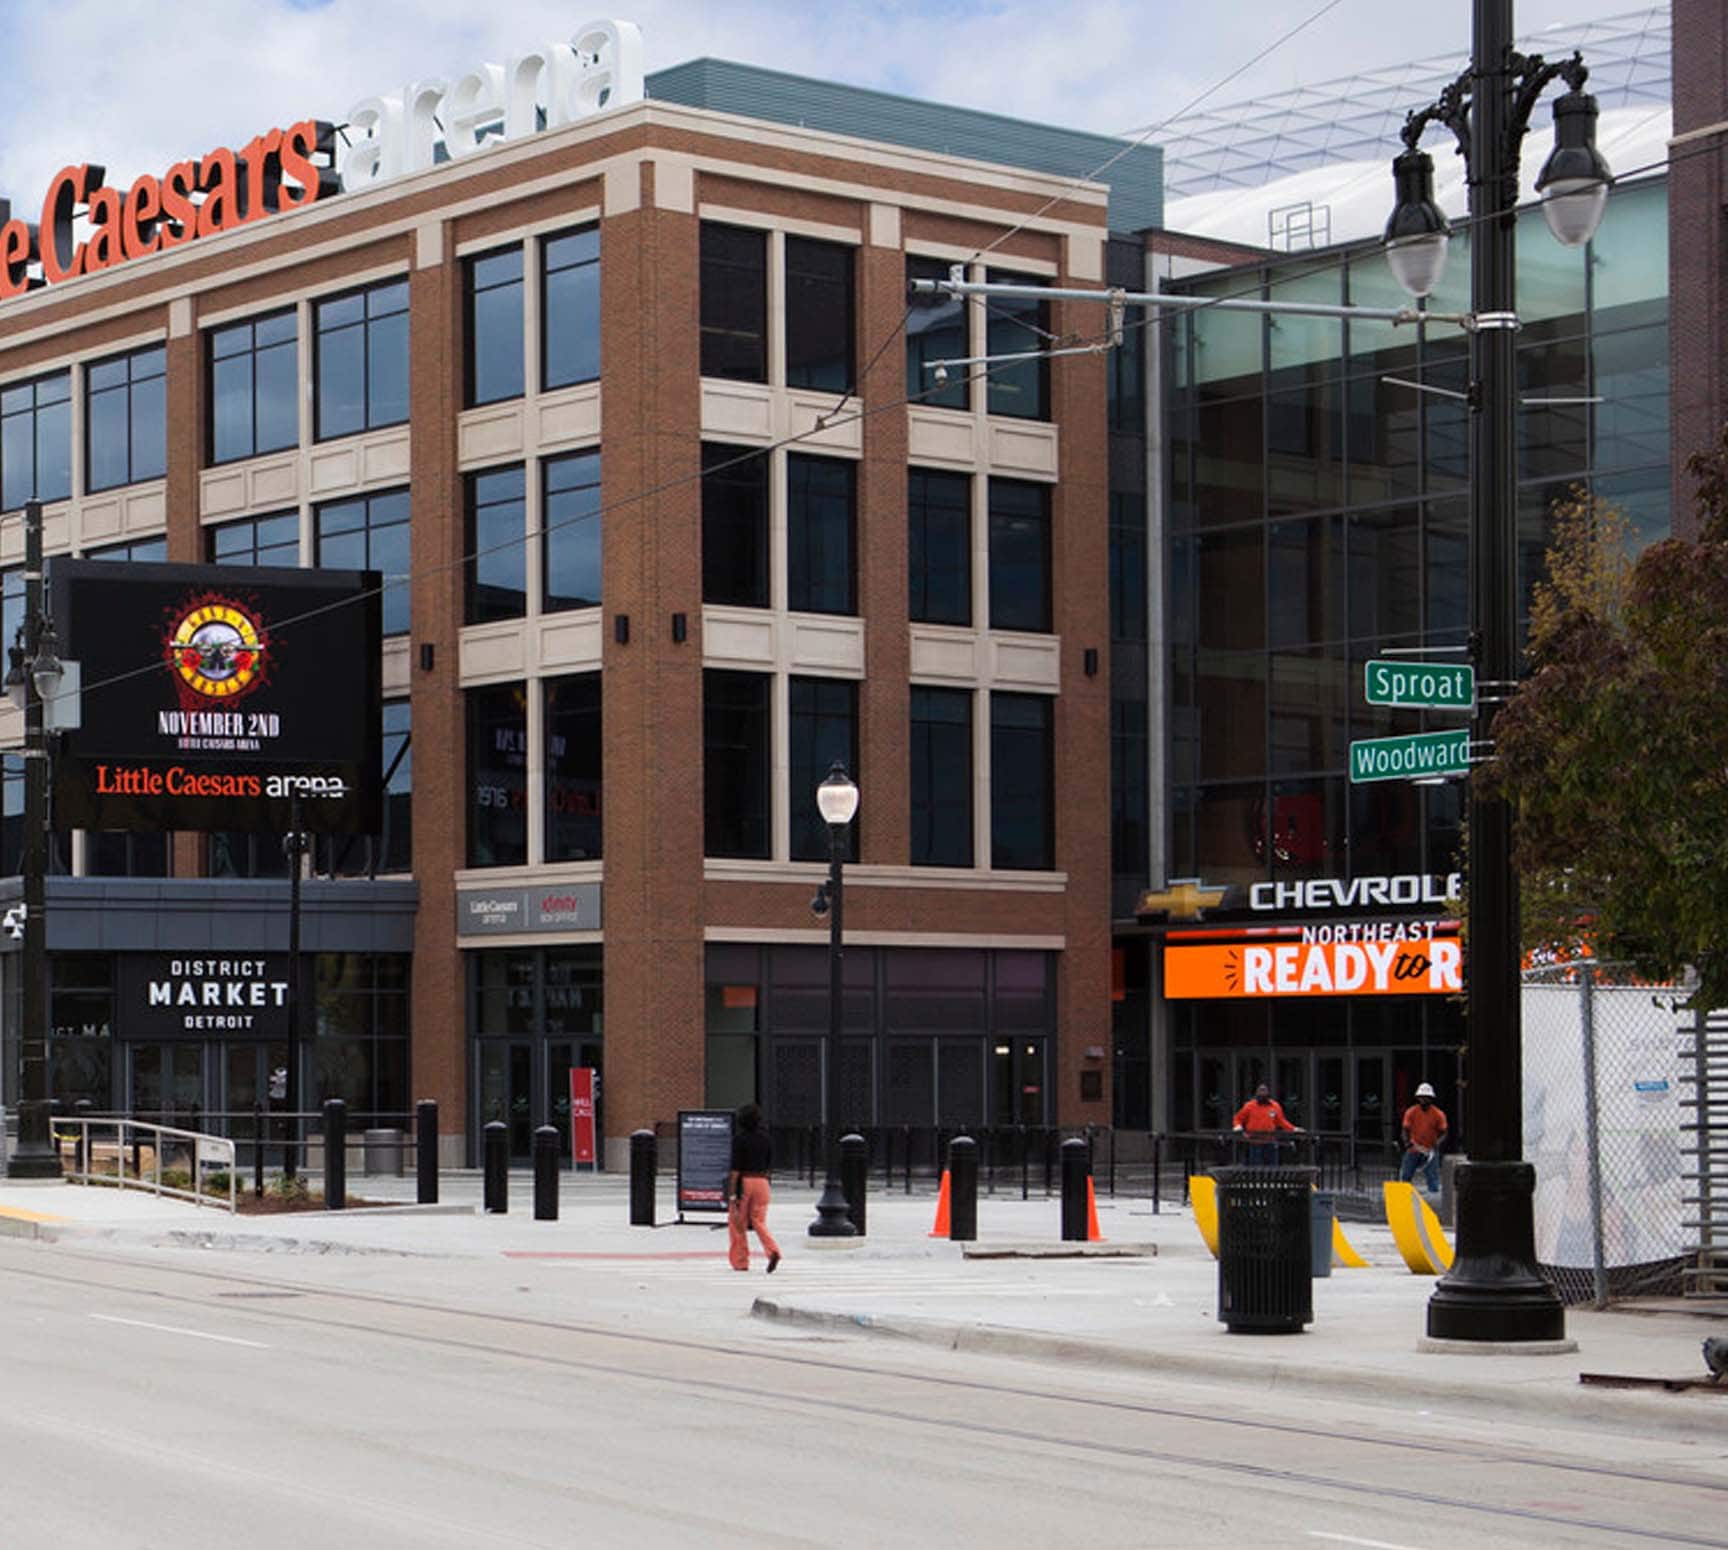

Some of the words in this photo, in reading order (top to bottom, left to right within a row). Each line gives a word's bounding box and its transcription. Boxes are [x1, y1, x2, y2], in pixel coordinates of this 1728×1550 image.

[39, 119, 322, 284] Caesars
[341, 18, 643, 194] arena
[1375, 668, 1464, 704] Sproat
[158, 711, 243, 735] NOVEMBER
[247, 713, 280, 737] 2ND
[1357, 735, 1470, 774] Woodward
[96, 765, 163, 794] Little
[166, 767, 261, 797] Caesars
[266, 775, 345, 798] arena
[1249, 872, 1460, 911] CHEVROLE
[1302, 920, 1437, 945] NORTHEAST
[171, 960, 266, 976] DISTRICT
[1244, 943, 1400, 994] READY
[1393, 953, 1433, 981] to
[149, 981, 288, 1006] MARKET
[184, 1015, 254, 1028] DETROIT
